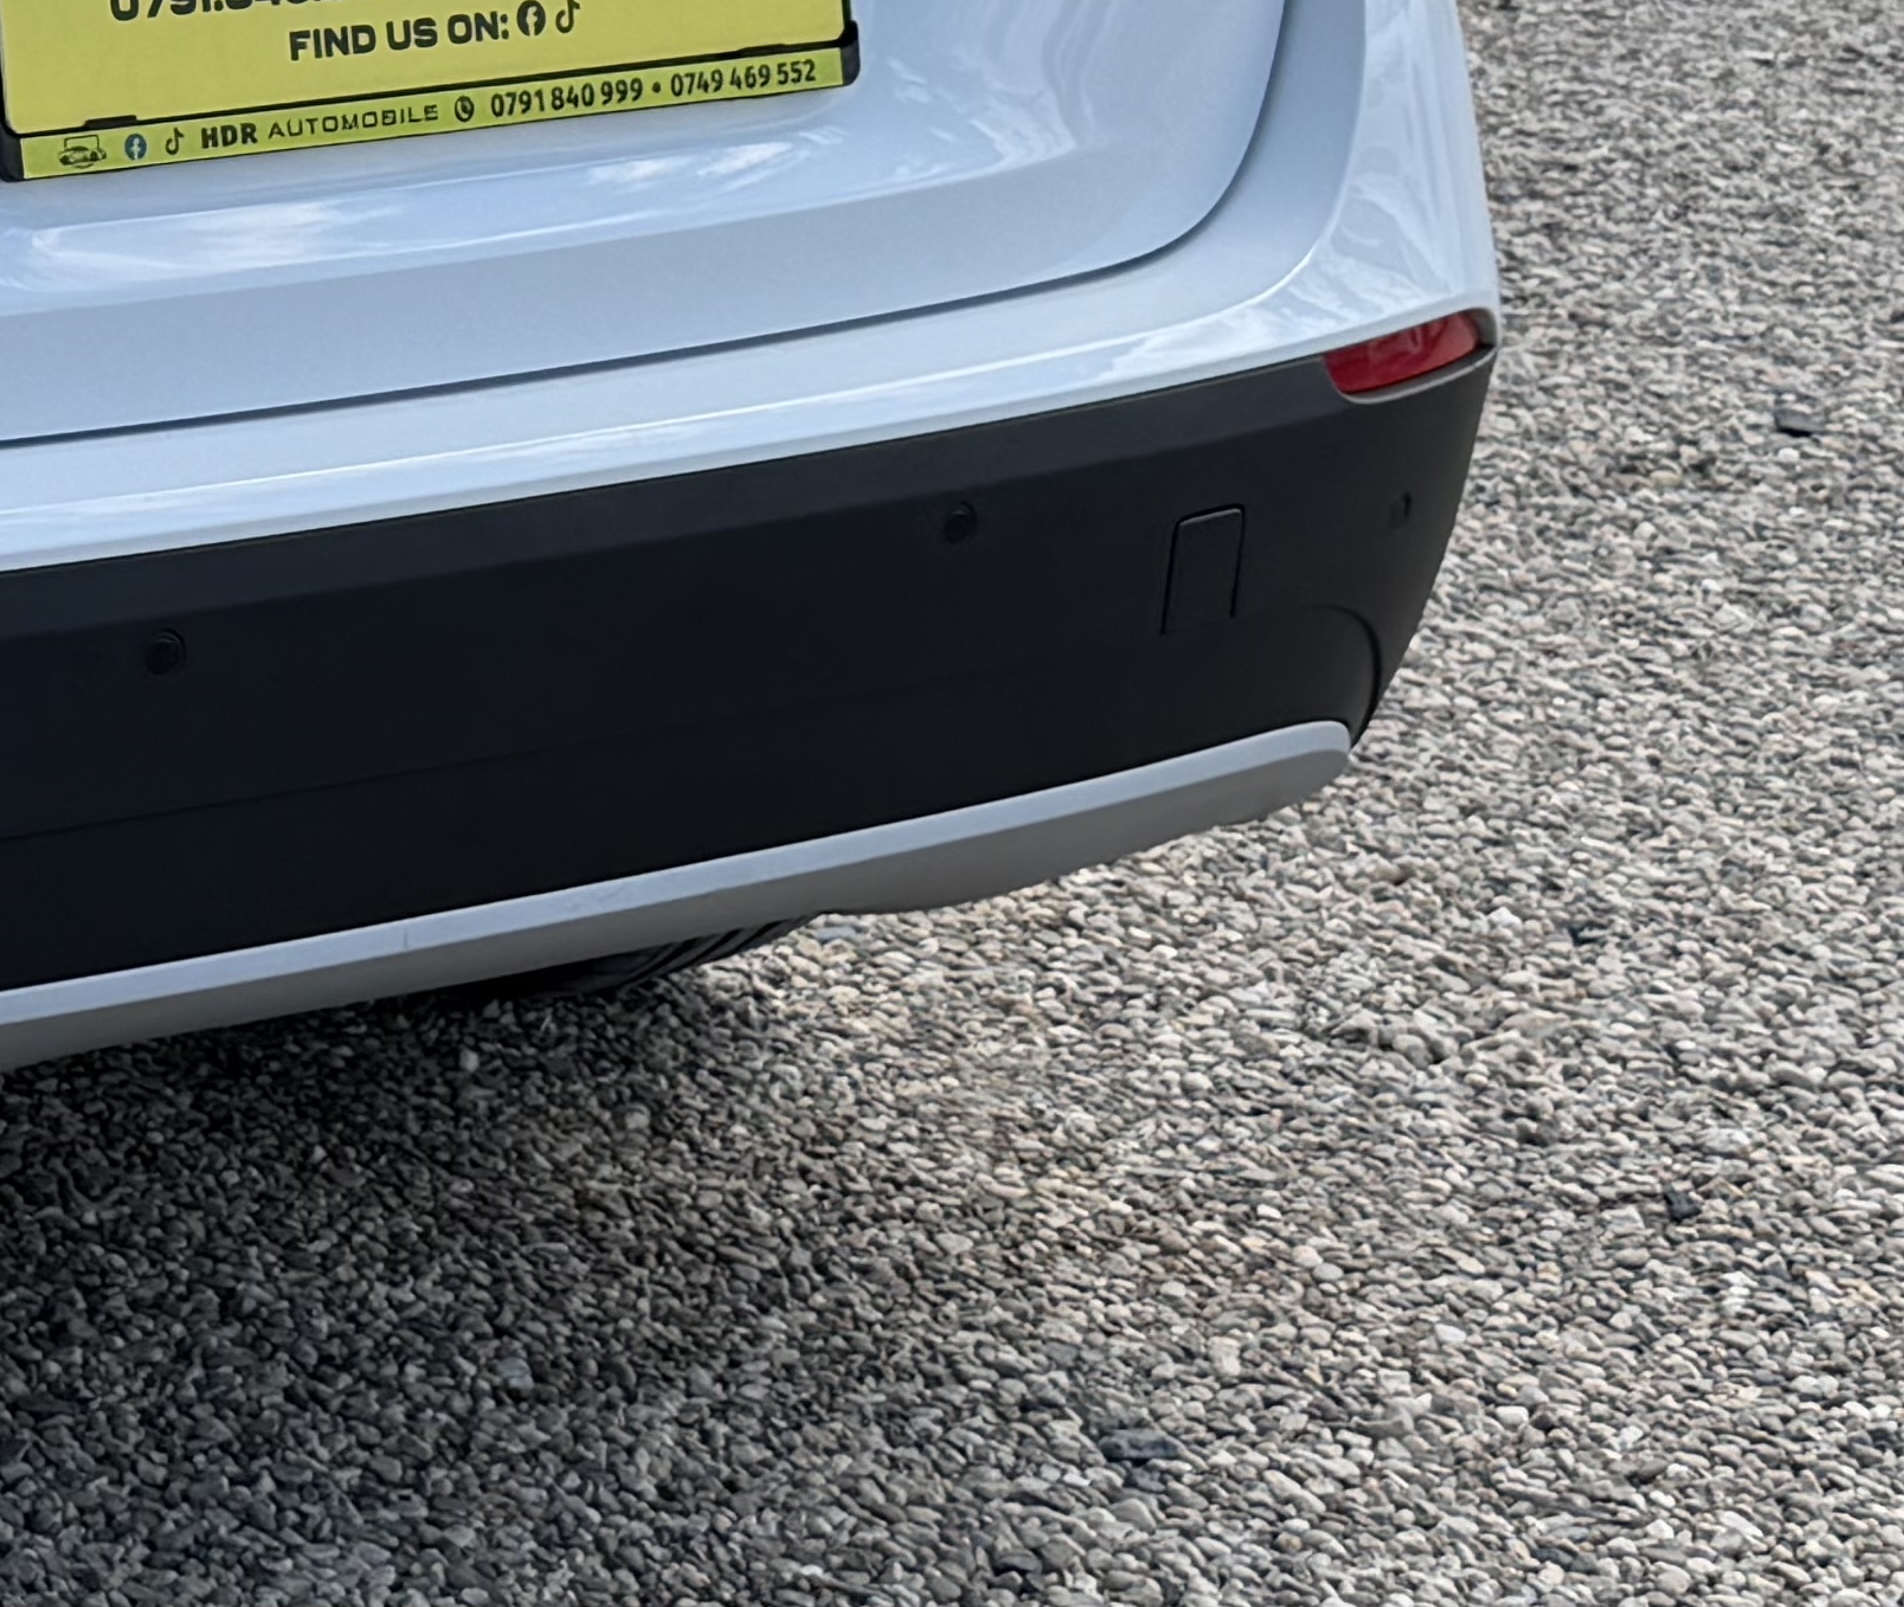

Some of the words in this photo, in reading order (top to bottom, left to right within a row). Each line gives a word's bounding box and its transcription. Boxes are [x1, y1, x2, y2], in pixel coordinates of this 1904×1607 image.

[289, 24, 376, 61] FIND
[386, 17, 439, 50] US
[447, 10, 509, 45] ON:
[200, 122, 258, 149] HDR
[268, 104, 438, 140] AUTOMOBILE
[601, 77, 644, 106] 999
[670, 69, 723, 97] 0749
[729, 64, 772, 90] 469
[777, 59, 817, 86] 552
